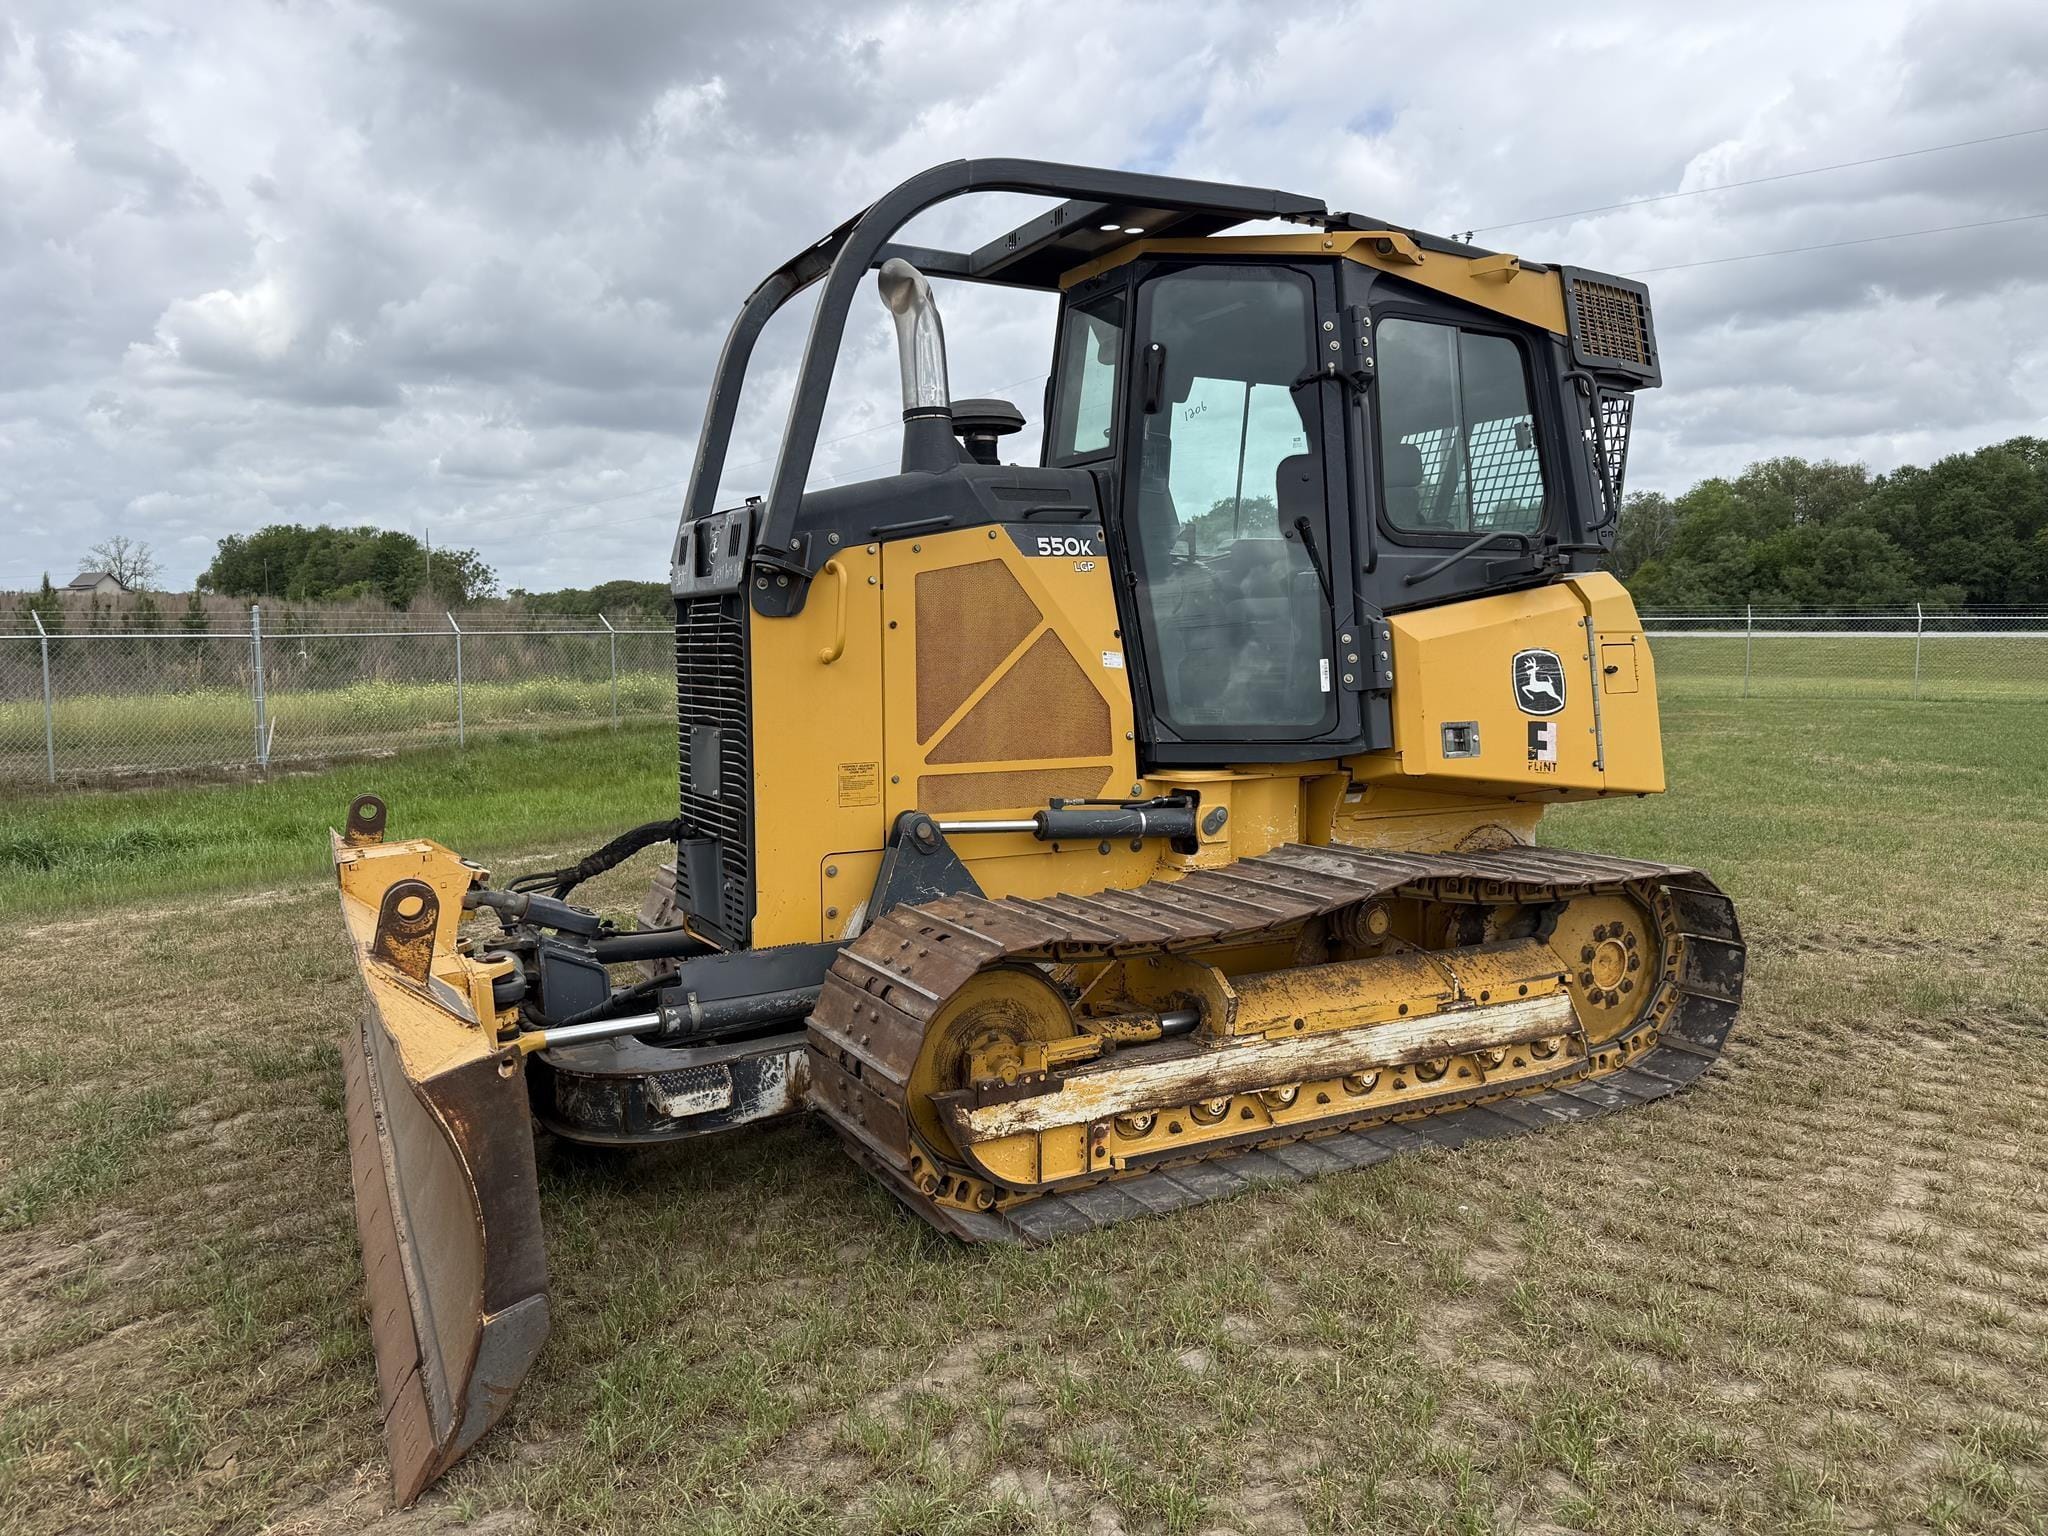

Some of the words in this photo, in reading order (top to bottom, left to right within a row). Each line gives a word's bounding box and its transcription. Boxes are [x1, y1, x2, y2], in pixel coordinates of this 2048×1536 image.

[1185, 401, 1207, 421] 1206
[1037, 536, 1095, 556] 550K
[1073, 561, 1095, 572] LGP
[1528, 761, 1557, 773] FLINT
